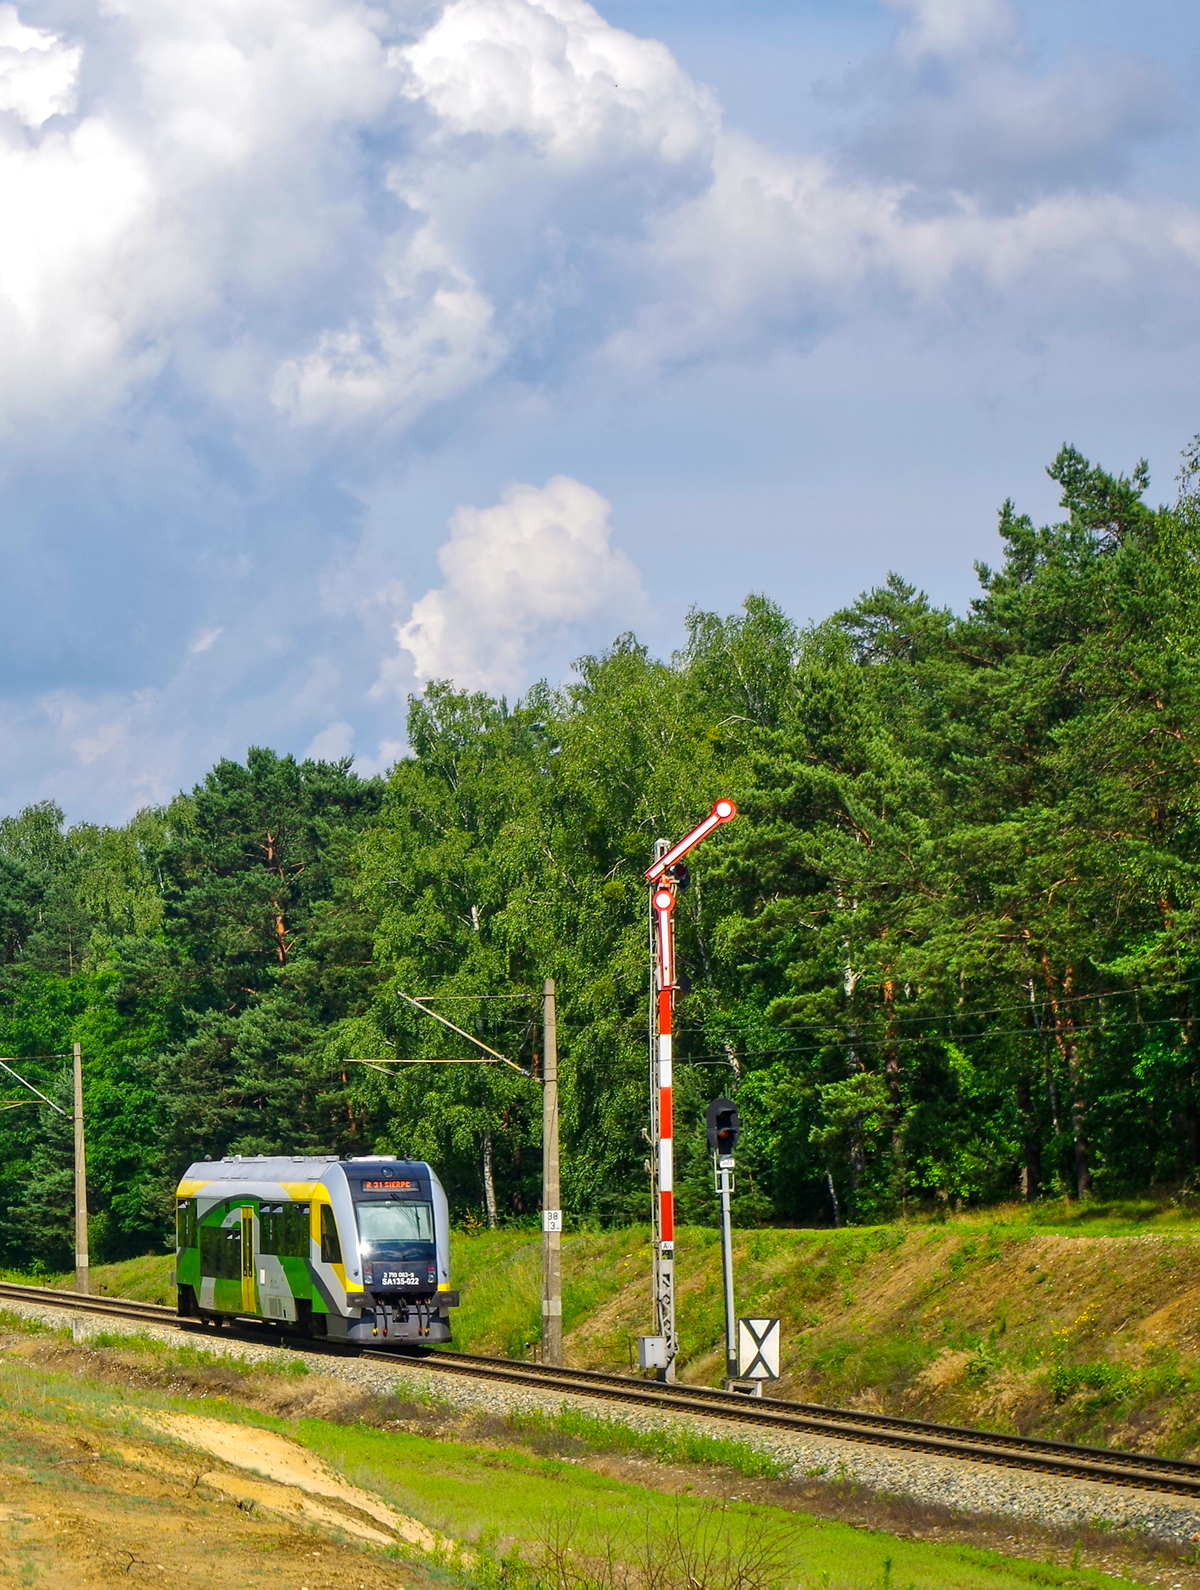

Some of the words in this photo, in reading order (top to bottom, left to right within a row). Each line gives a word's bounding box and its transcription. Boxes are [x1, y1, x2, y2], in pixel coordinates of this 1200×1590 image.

[384, 1180, 411, 1188] SIERPC
[547, 1211, 558, 1221] 38
[550, 1221, 556, 1230] 3
[381, 1277, 420, 1286] SA135-022
